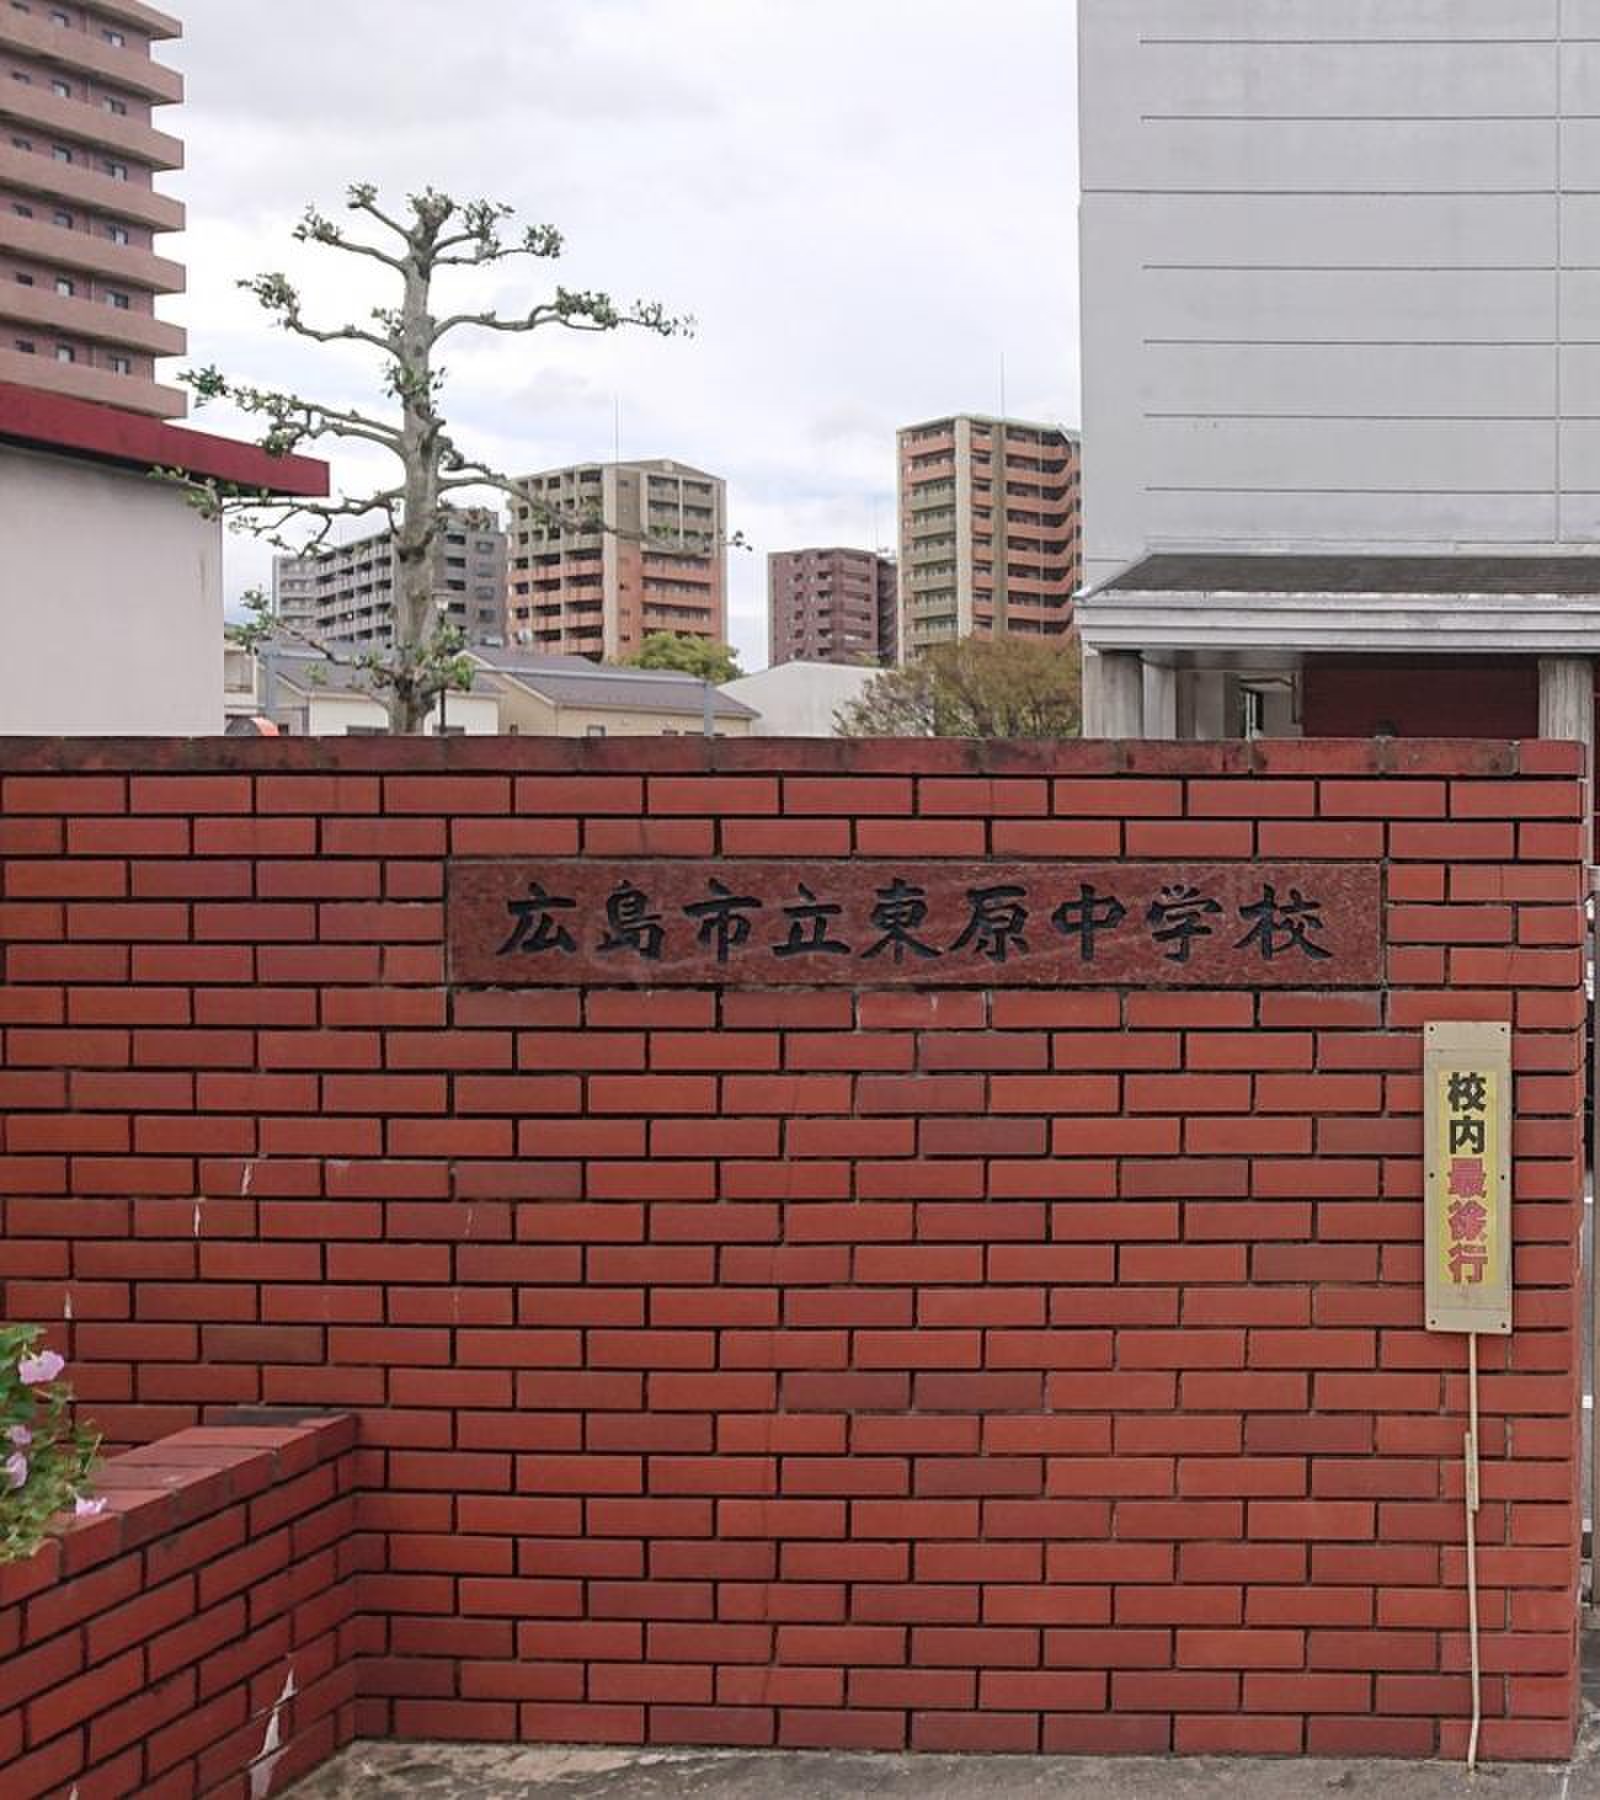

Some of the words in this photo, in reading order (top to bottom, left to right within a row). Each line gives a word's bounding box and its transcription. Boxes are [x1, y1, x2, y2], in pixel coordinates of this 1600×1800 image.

[494, 876, 1335, 966] 広島市立東原中学校
[1447, 1071, 1489, 1284] 校内最徐行
